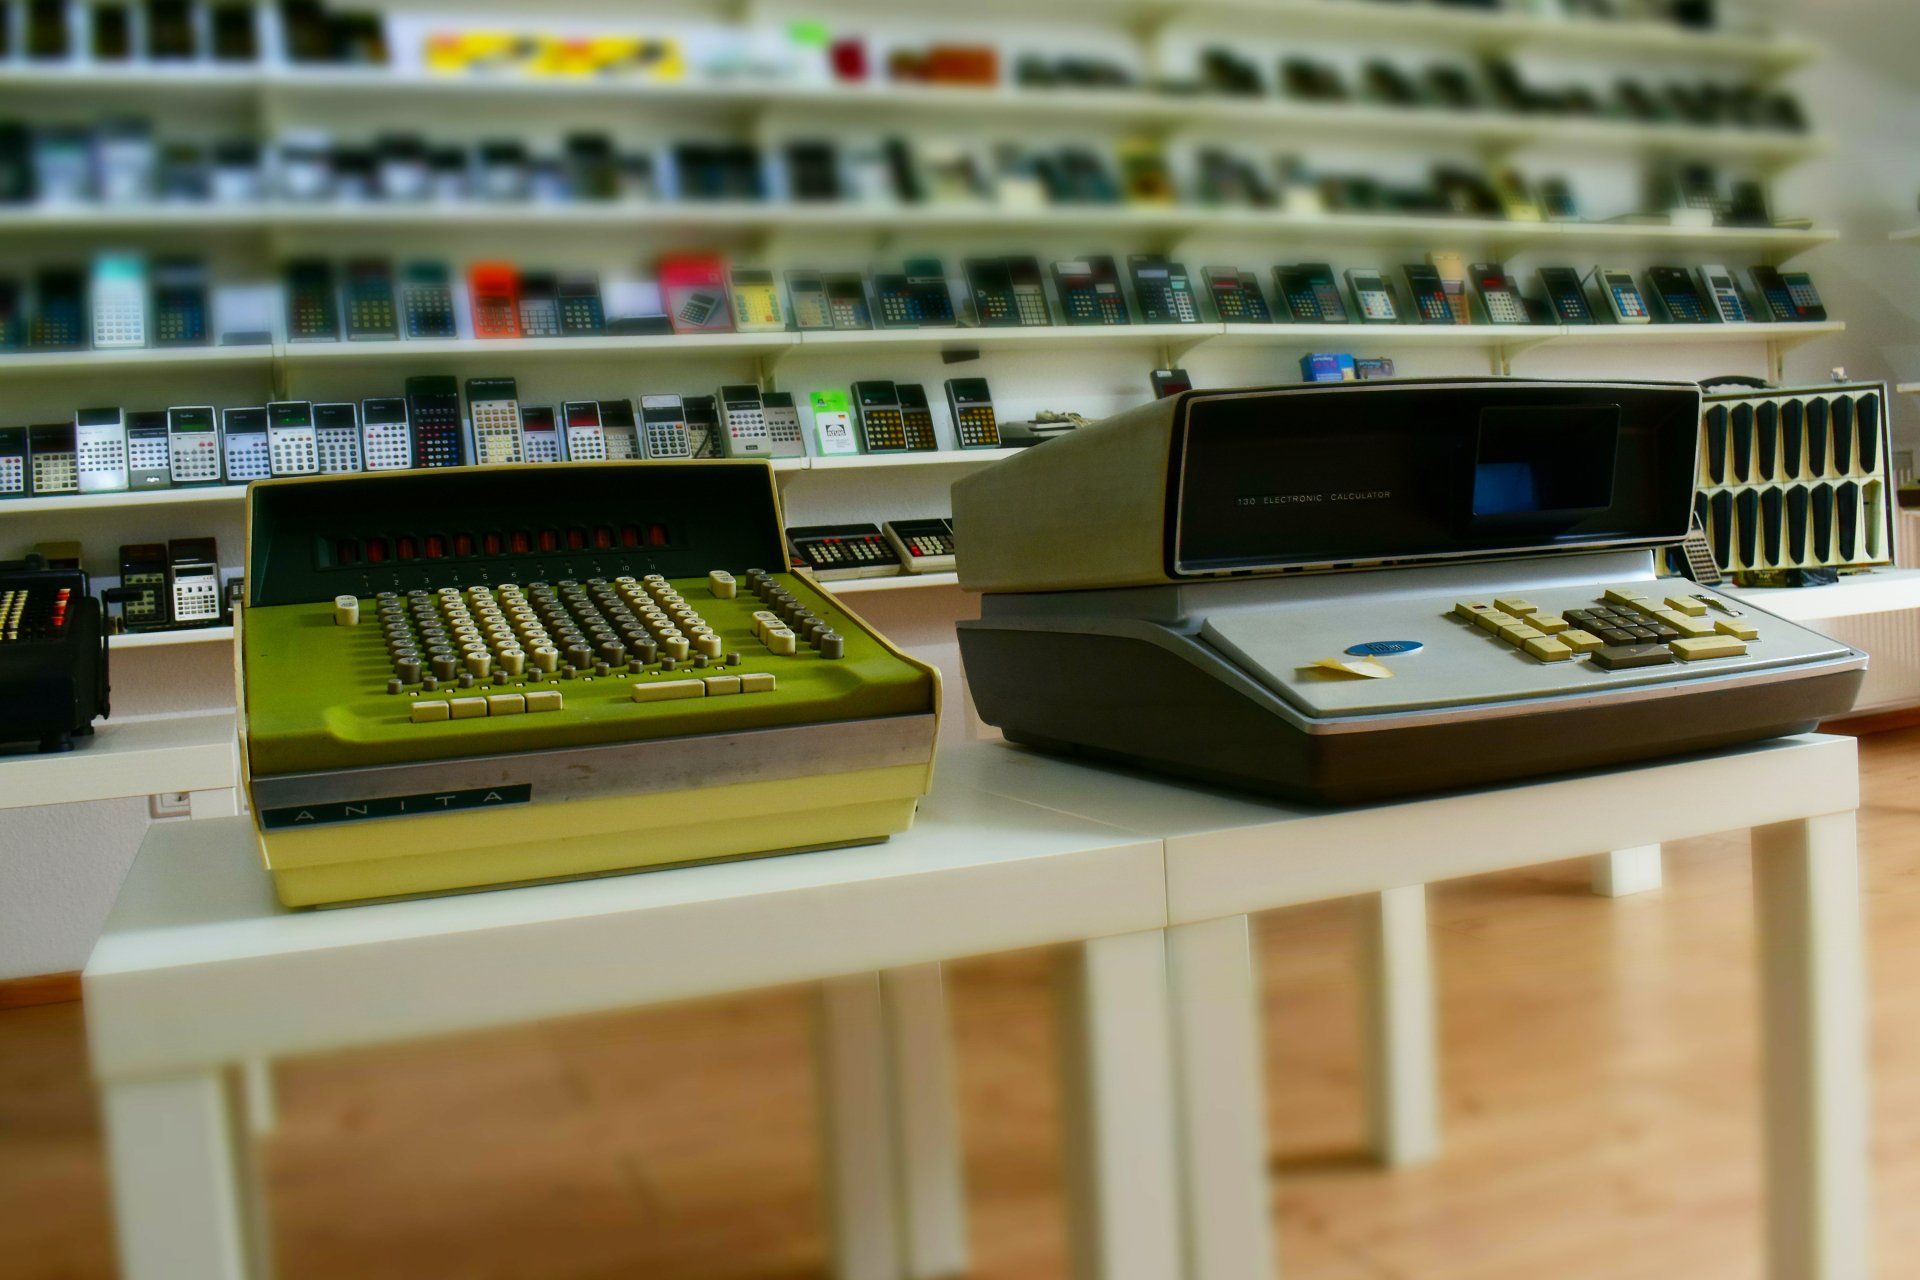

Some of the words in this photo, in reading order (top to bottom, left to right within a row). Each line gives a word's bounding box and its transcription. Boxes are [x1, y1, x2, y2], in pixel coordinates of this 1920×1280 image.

[1263, 495, 1322, 504] ELECTRONIC
[1330, 491, 1391, 502] CALCULATOR
[295, 791, 503, 821] ANITA
